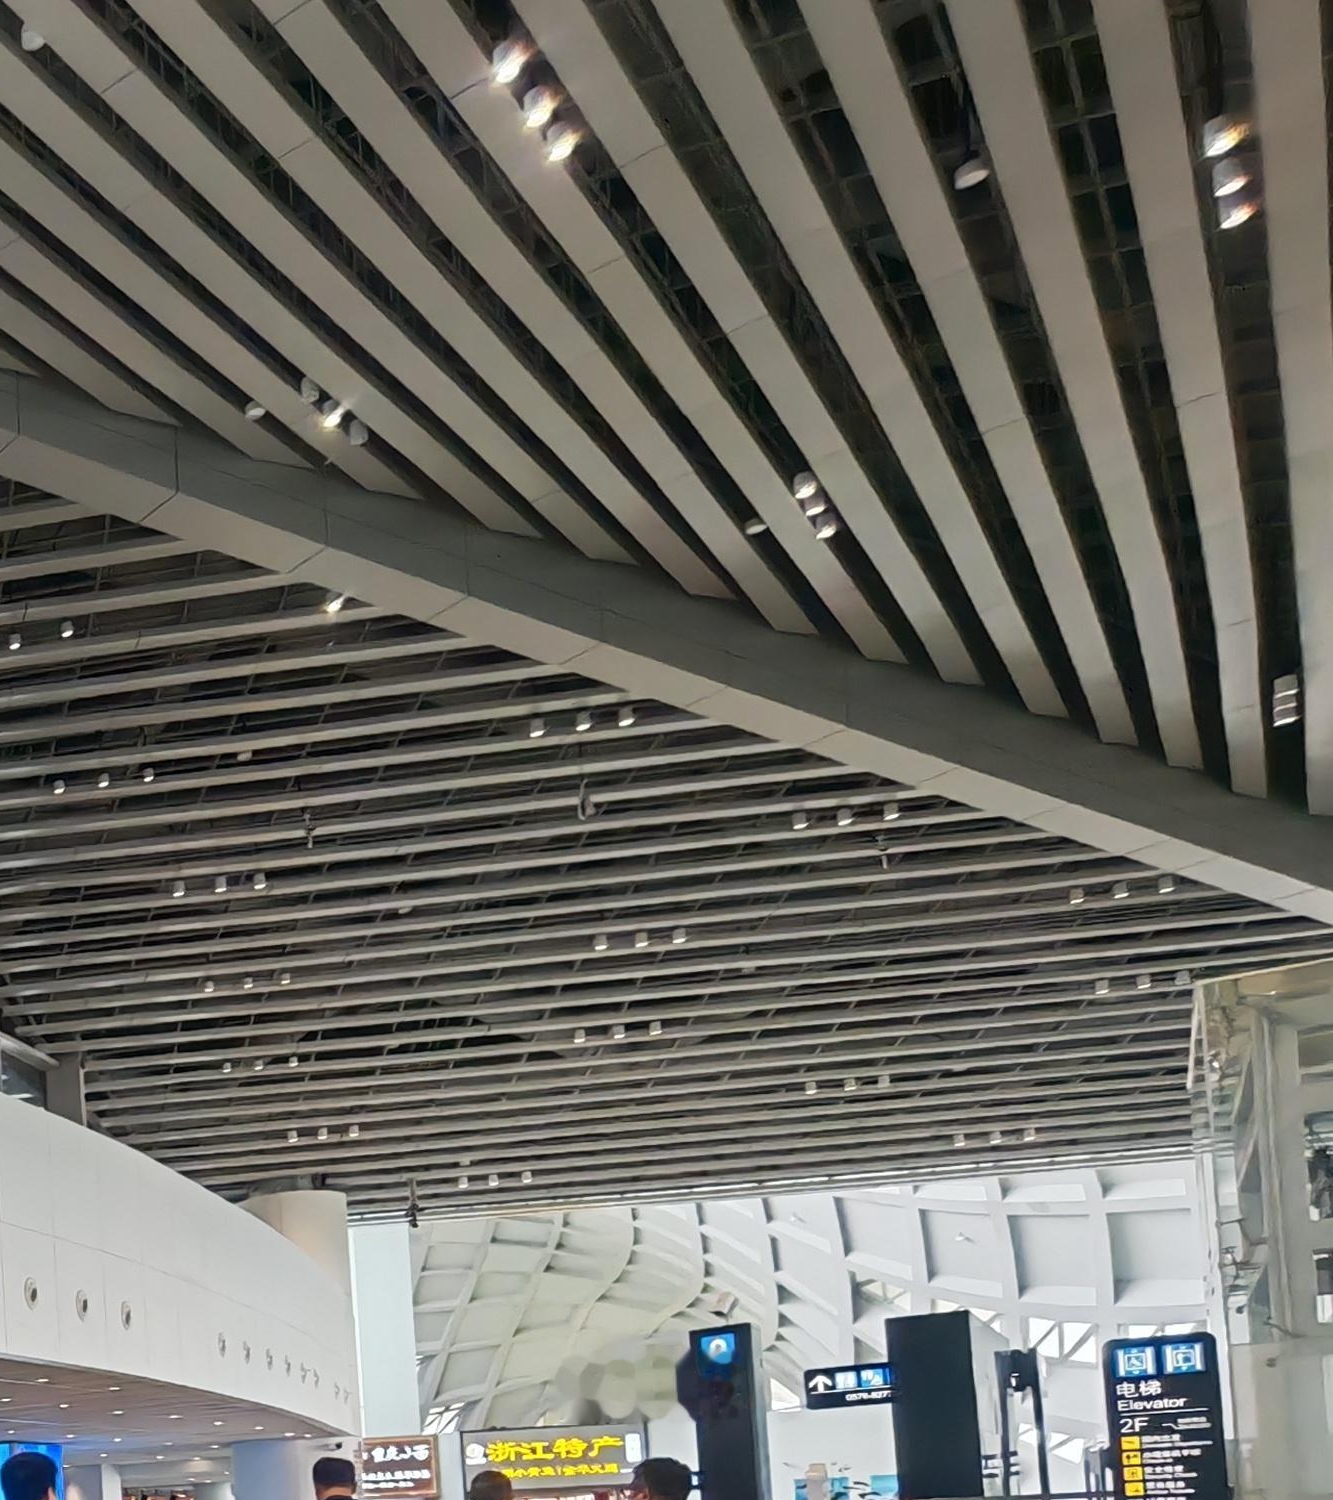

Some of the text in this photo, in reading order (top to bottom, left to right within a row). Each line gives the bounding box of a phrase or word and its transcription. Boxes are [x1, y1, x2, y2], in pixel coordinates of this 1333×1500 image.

[1116, 1380, 1162, 1398] 电梯
[1118, 1398, 1187, 1411] Elevator
[1120, 1417, 1149, 1433] 2F
[486, 1436, 624, 1462] 浙江特产
